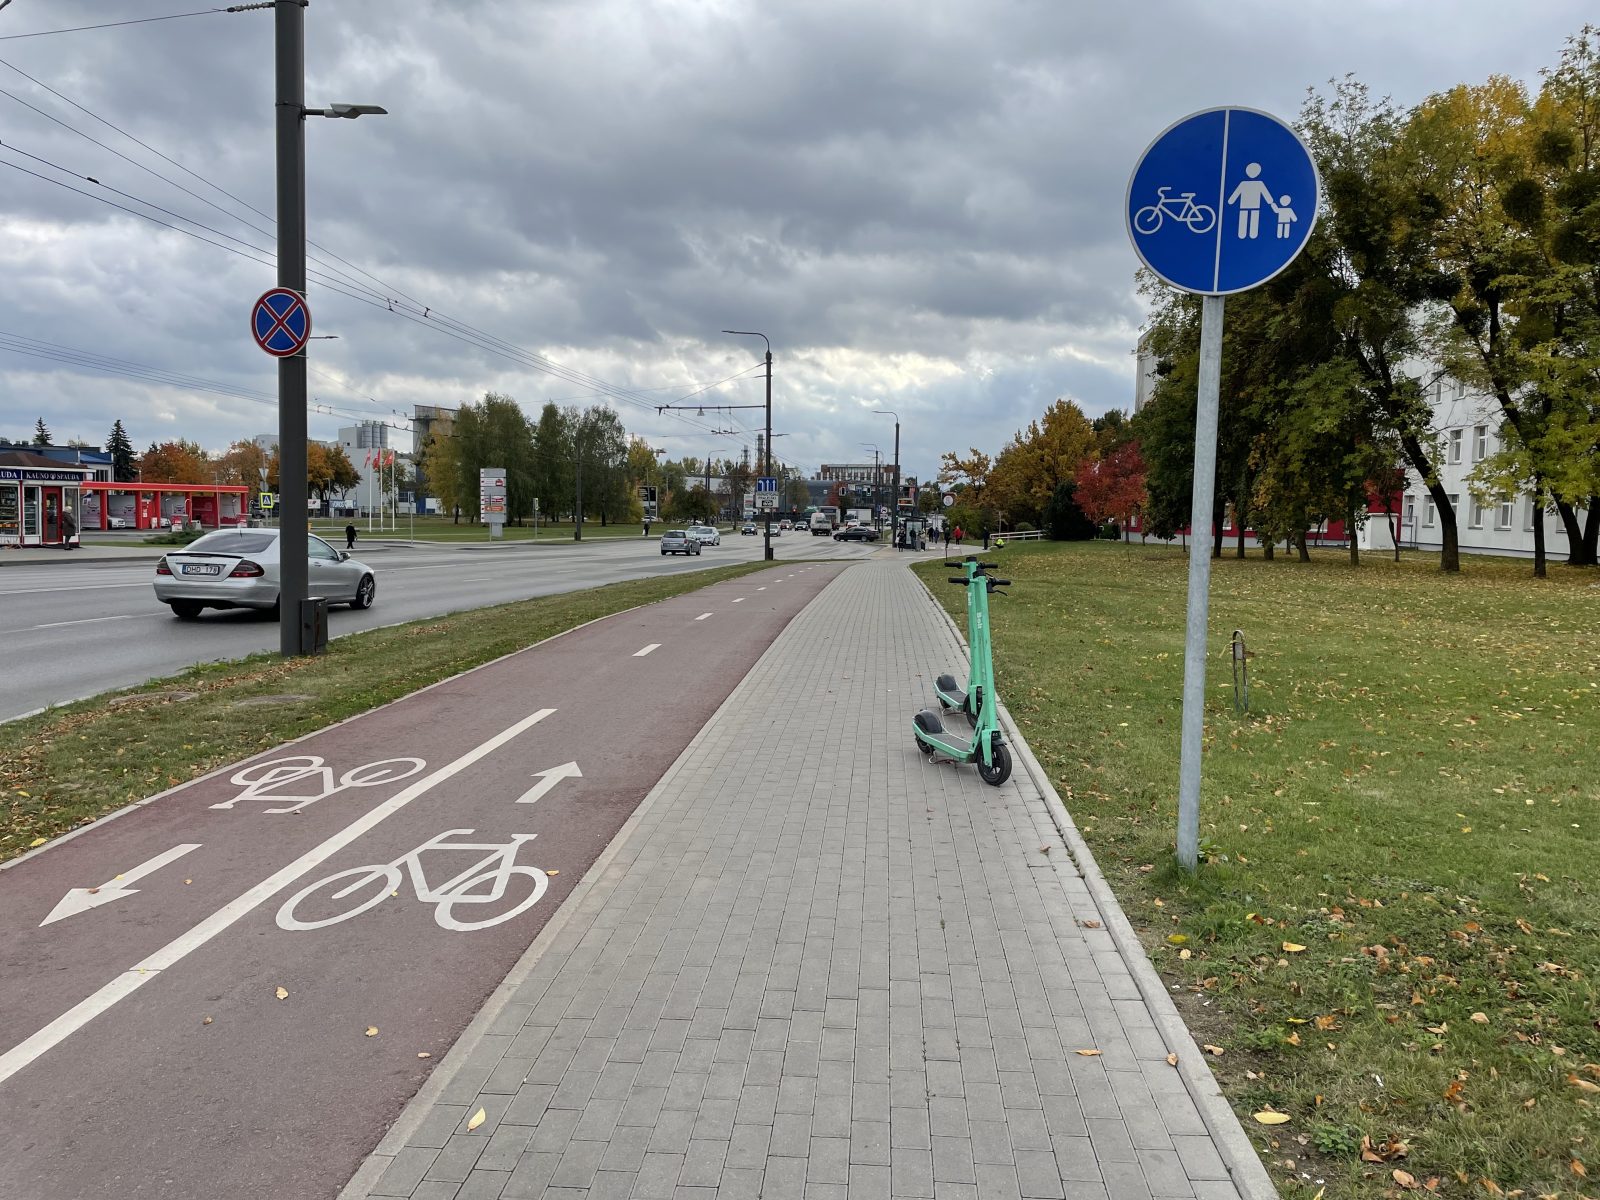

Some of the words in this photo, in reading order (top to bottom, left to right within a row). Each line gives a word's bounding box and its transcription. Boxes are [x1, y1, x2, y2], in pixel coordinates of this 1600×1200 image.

[0, 470, 18, 479] UDA
[26, 472, 49, 480] KAUNO
[57, 473, 80, 481] SPAUDA
